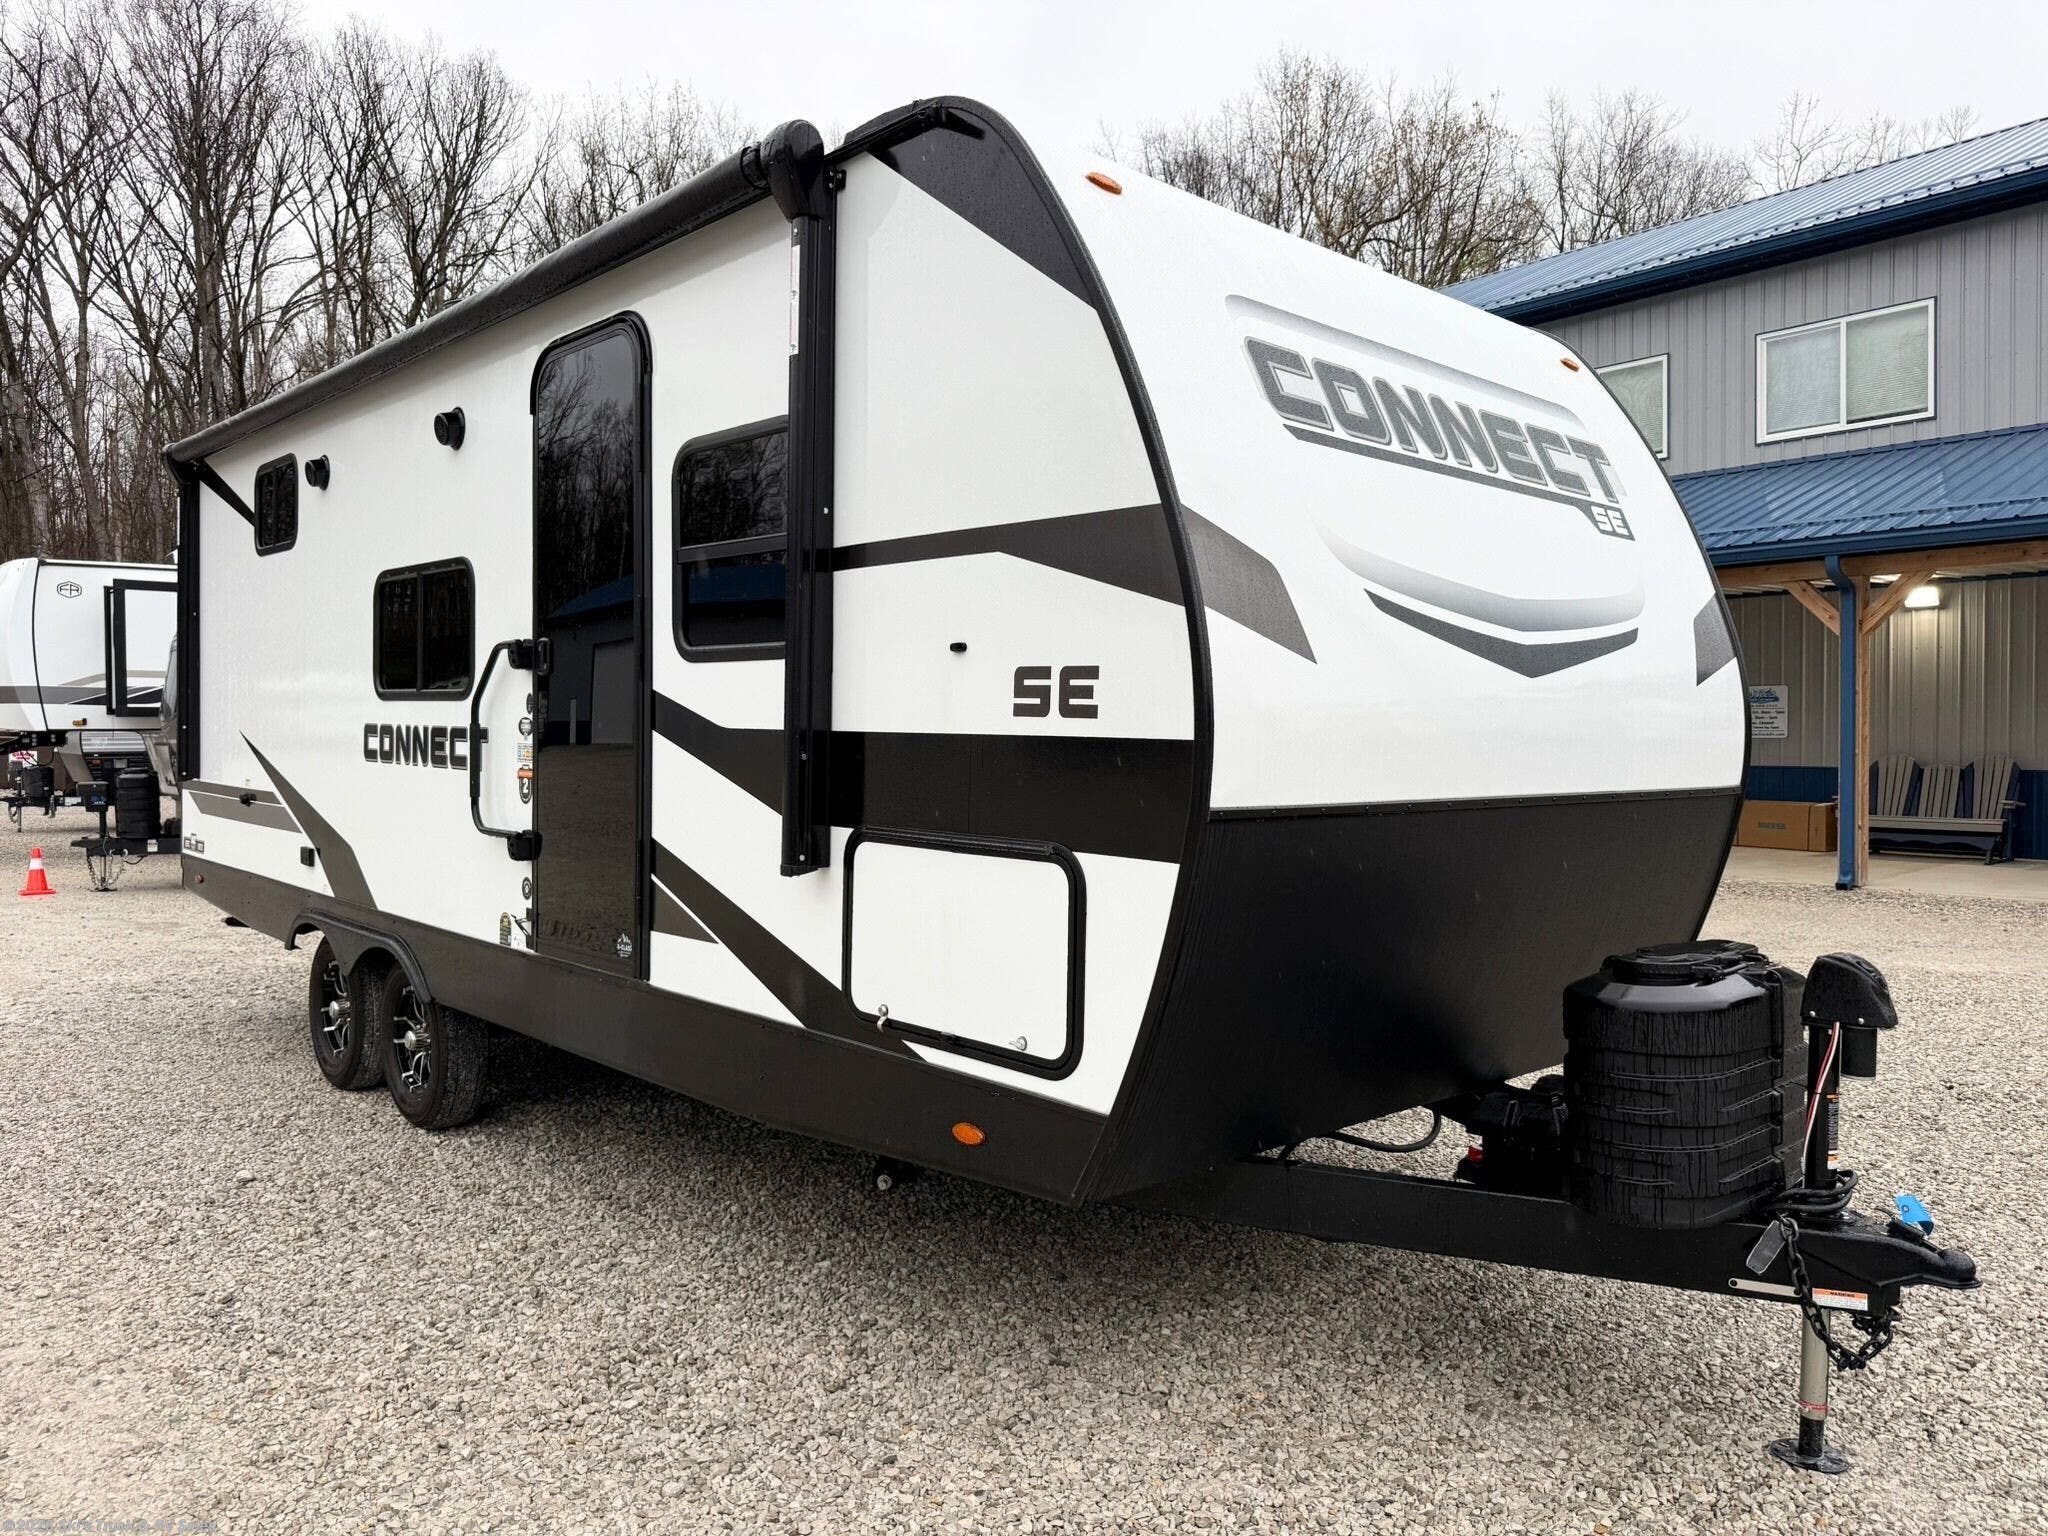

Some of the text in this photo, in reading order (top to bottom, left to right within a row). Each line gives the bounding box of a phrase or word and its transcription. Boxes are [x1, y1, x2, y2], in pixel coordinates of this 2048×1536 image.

[1244, 335, 1619, 504] CONNECT
[1590, 505, 1630, 536] SE
[1013, 665, 1100, 719] SE
[522, 778, 529, 793] 2
